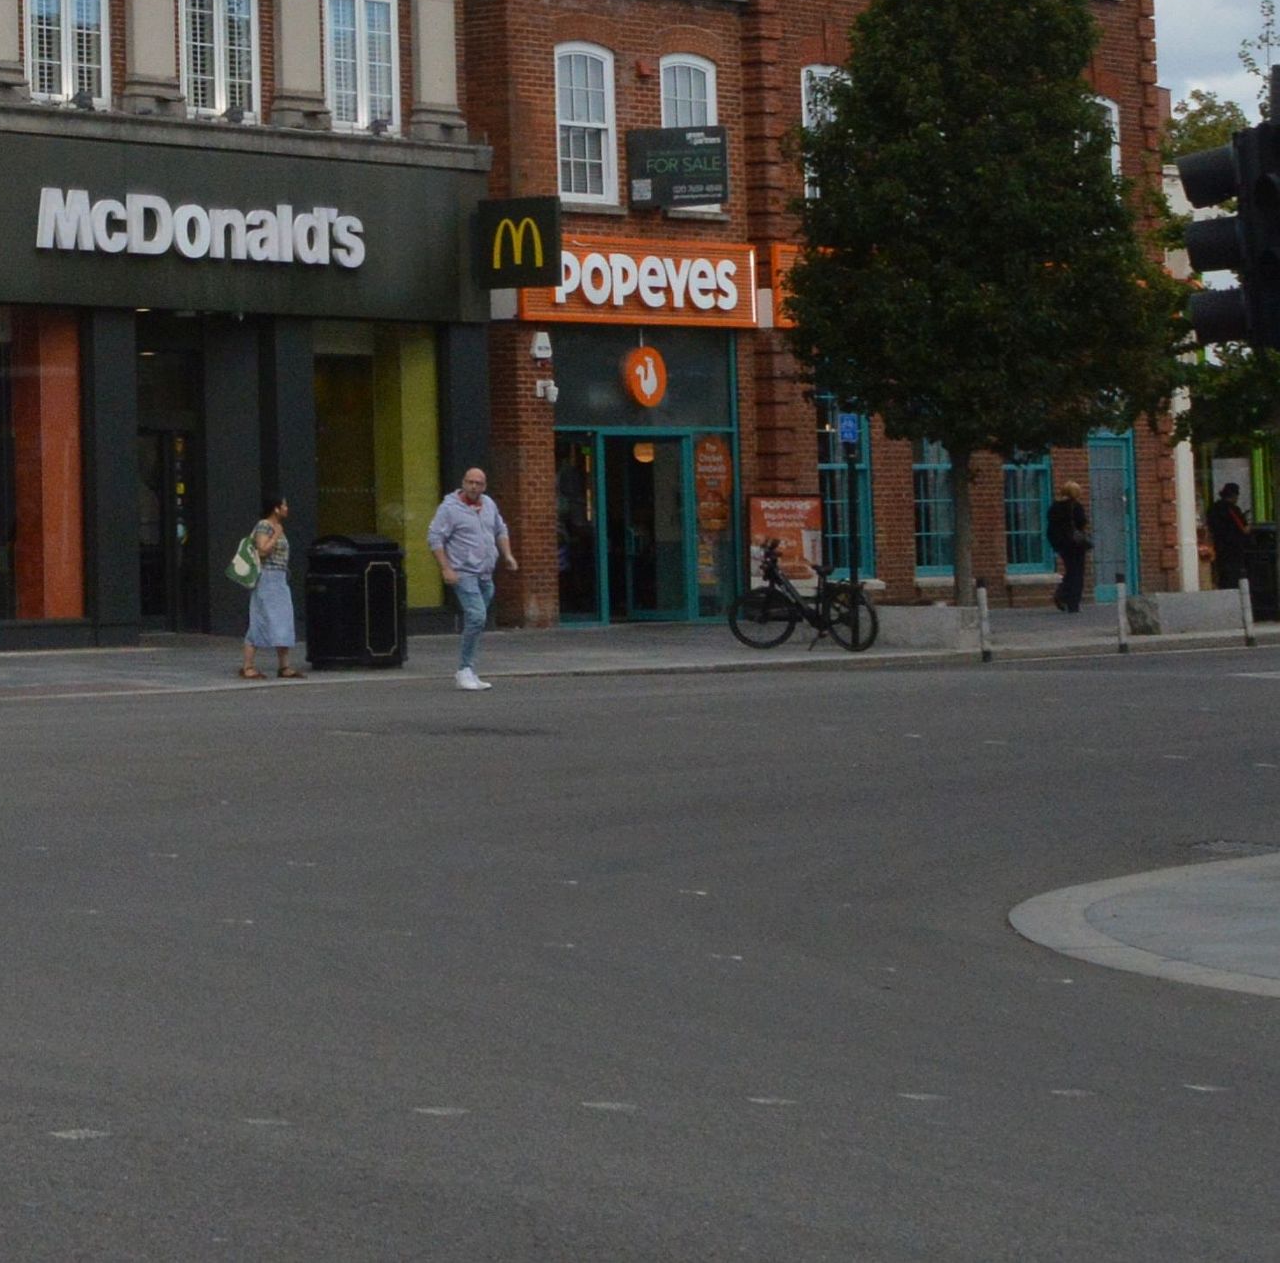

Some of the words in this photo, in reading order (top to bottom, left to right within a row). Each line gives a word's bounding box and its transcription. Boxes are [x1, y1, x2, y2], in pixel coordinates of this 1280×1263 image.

[646, 158, 679, 174] FOR
[682, 156, 722, 172] SALE
[36, 187, 366, 268] McDonald's
